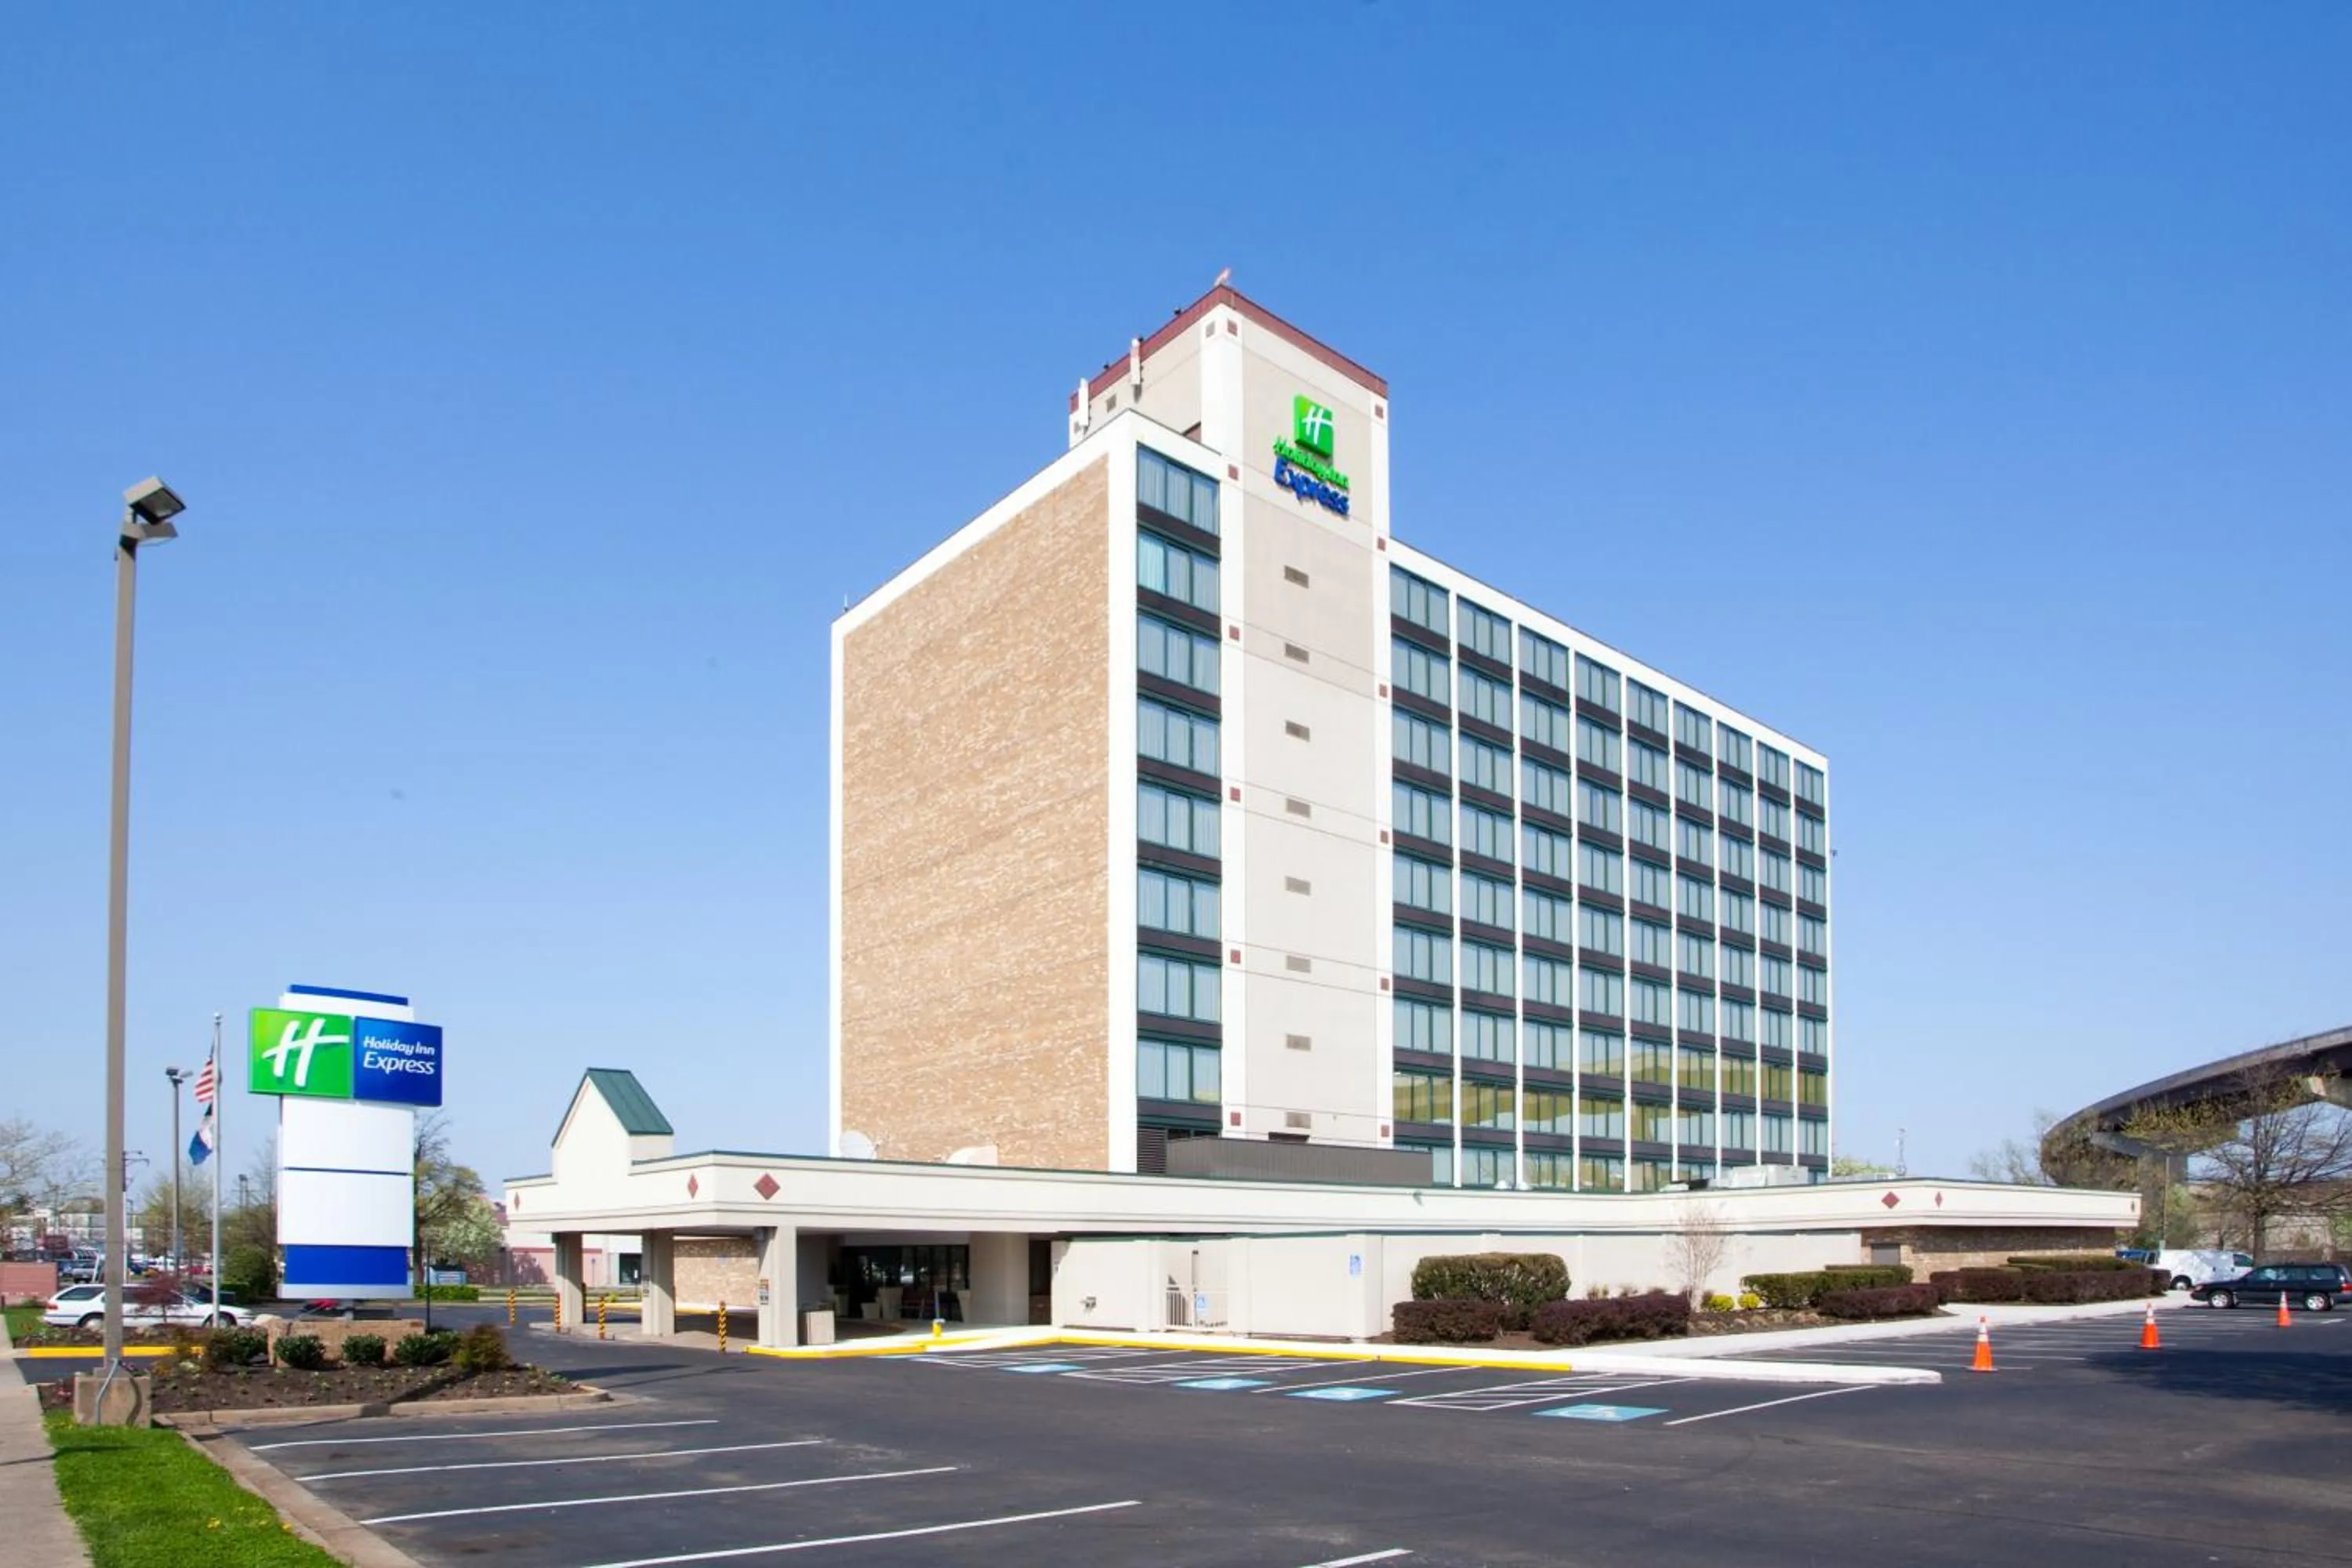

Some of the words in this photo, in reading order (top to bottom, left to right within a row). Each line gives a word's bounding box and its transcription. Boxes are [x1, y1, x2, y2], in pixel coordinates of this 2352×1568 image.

[1274, 455, 1350, 516] Express
[363, 1036, 414, 1055] Holiday
[416, 1041, 435, 1055] Inn
[363, 1051, 435, 1074] Express
